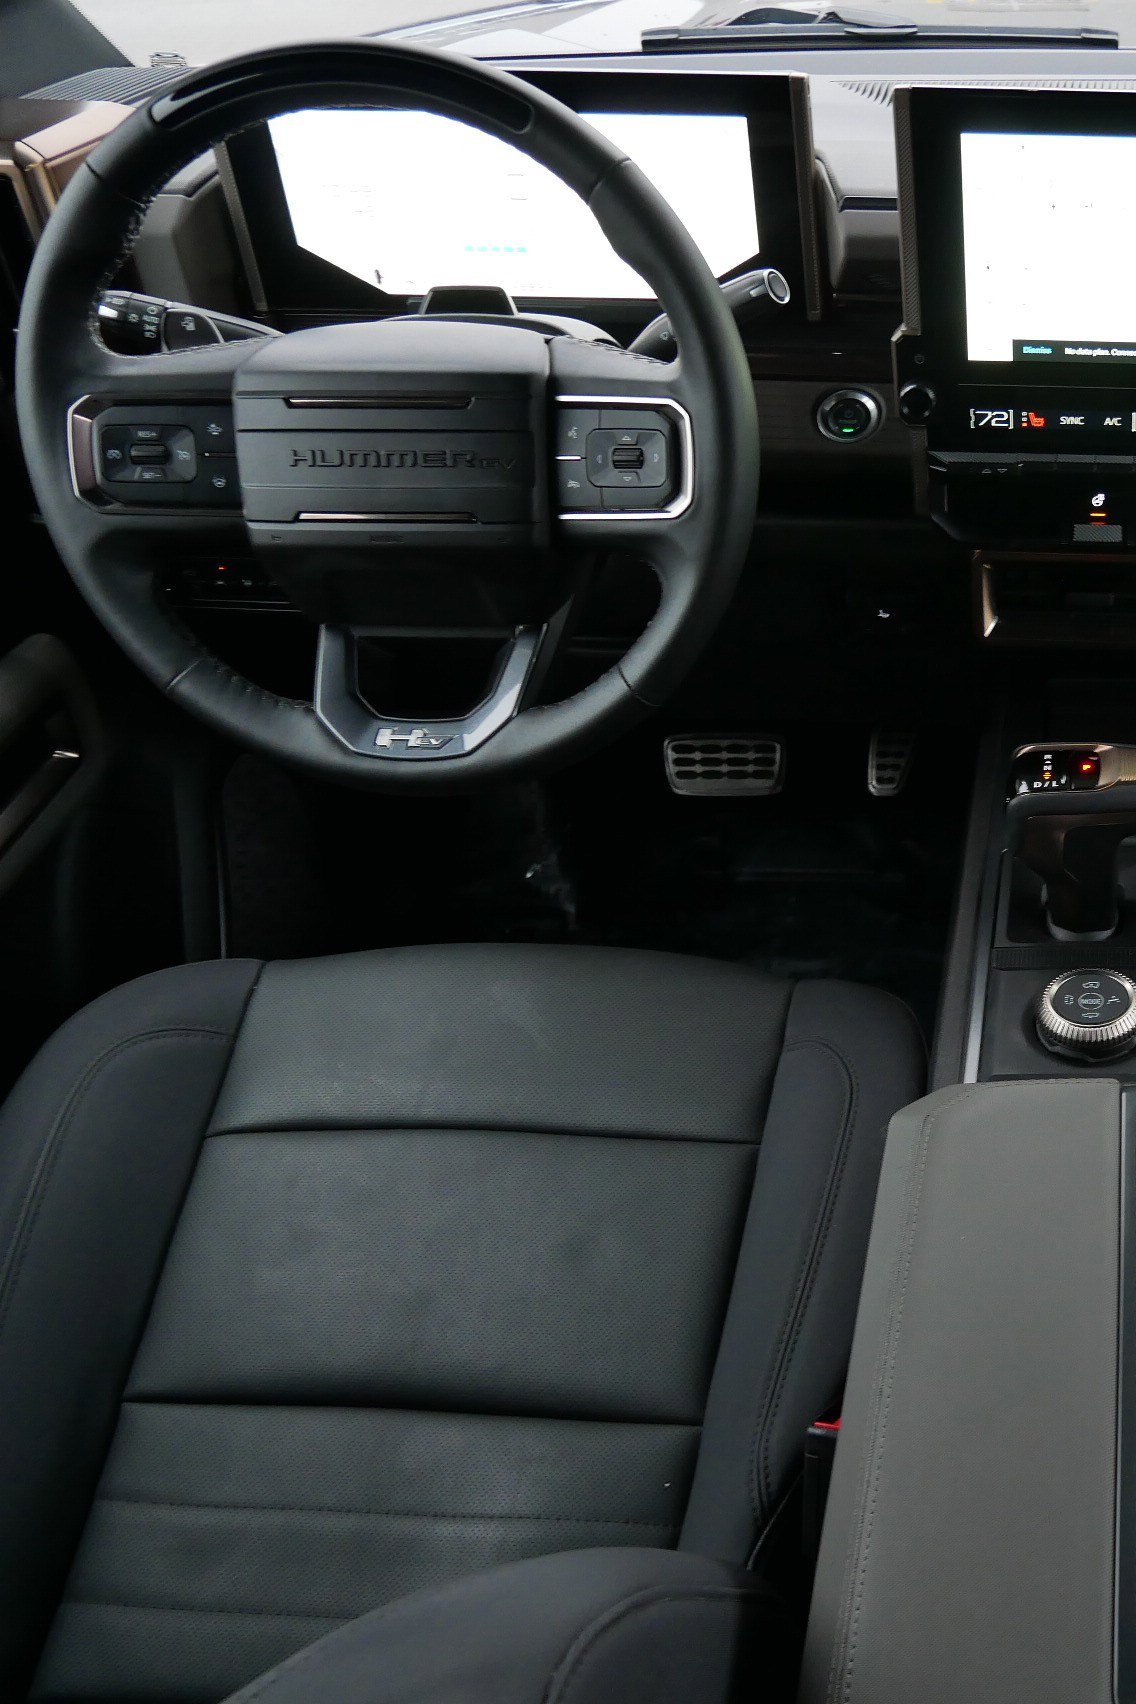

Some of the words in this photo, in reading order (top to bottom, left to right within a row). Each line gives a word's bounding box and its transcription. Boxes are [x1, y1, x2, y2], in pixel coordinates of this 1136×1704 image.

[1092, 348, 1110, 357] plan.
[974, 410, 1010, 427] 72
[1059, 416, 1085, 425] SYNC
[1103, 417, 1122, 426] A/C
[290, 449, 476, 468] HUMMER
